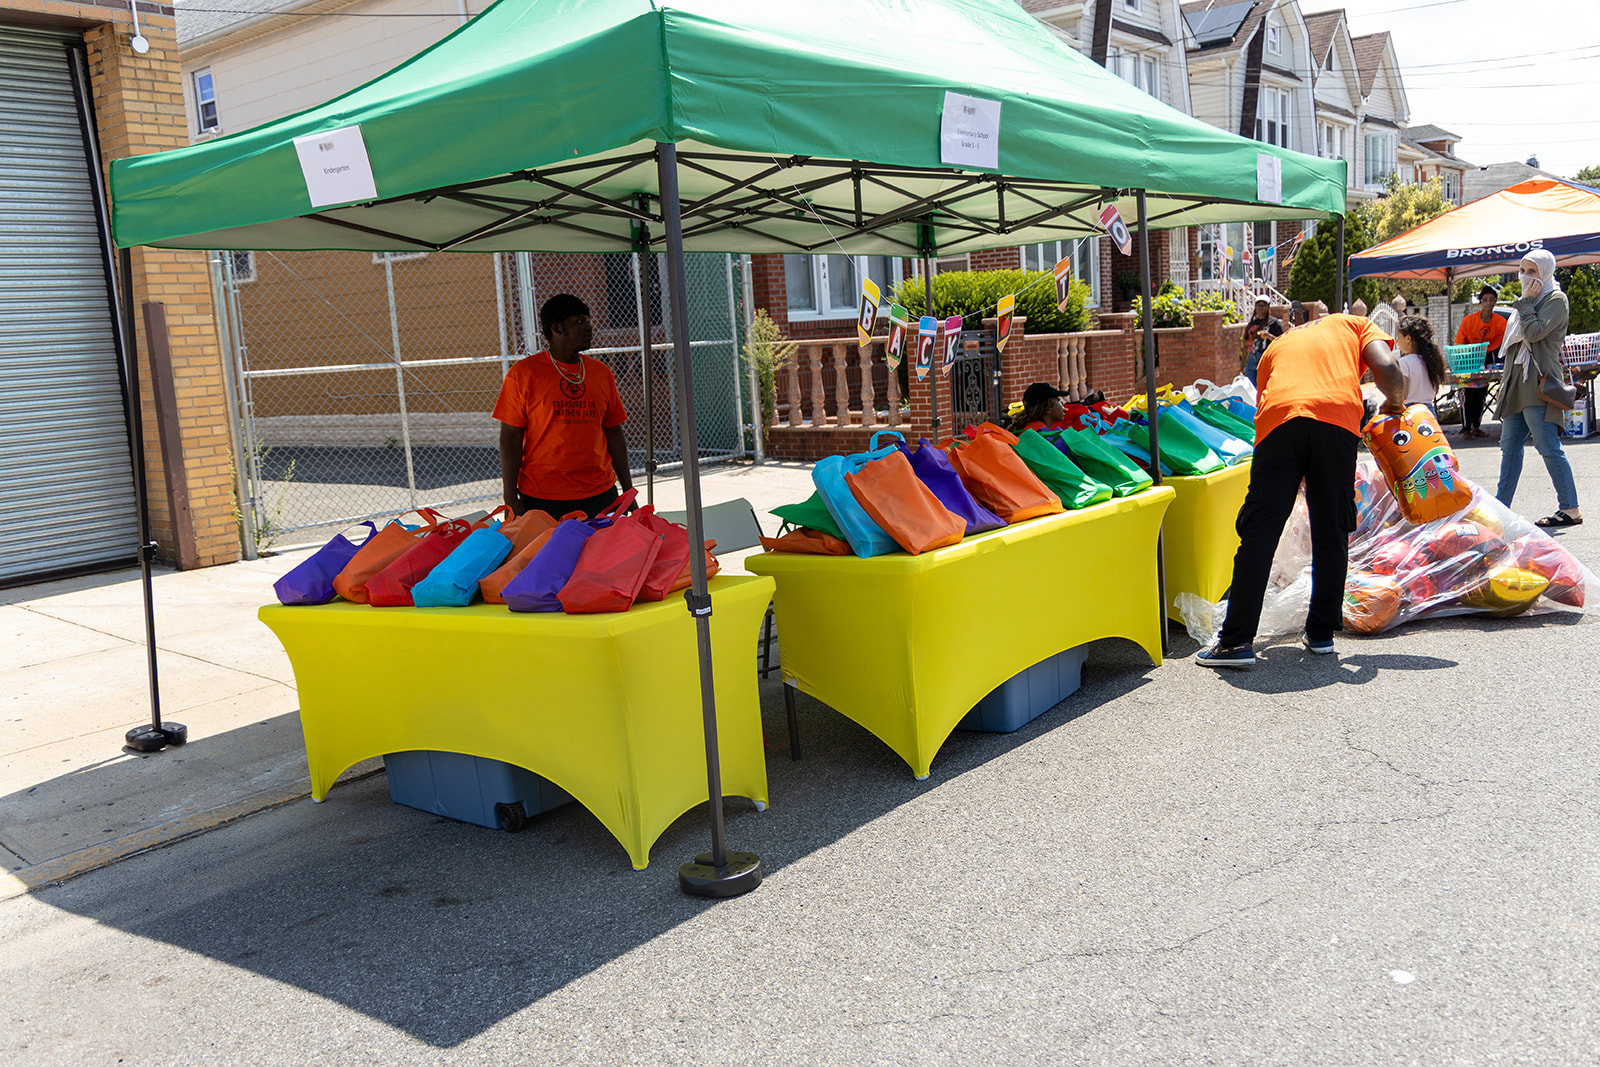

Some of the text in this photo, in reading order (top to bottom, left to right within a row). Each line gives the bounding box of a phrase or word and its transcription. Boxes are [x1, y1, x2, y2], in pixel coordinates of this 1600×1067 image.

[961, 141, 971, 149] Grade
[323, 165, 350, 174] Kindergarten
[1446, 239, 1544, 259] BRONCOS
[552, 400, 596, 409] TREASURES IN
[553, 409, 596, 418] EARTHEN JARS
